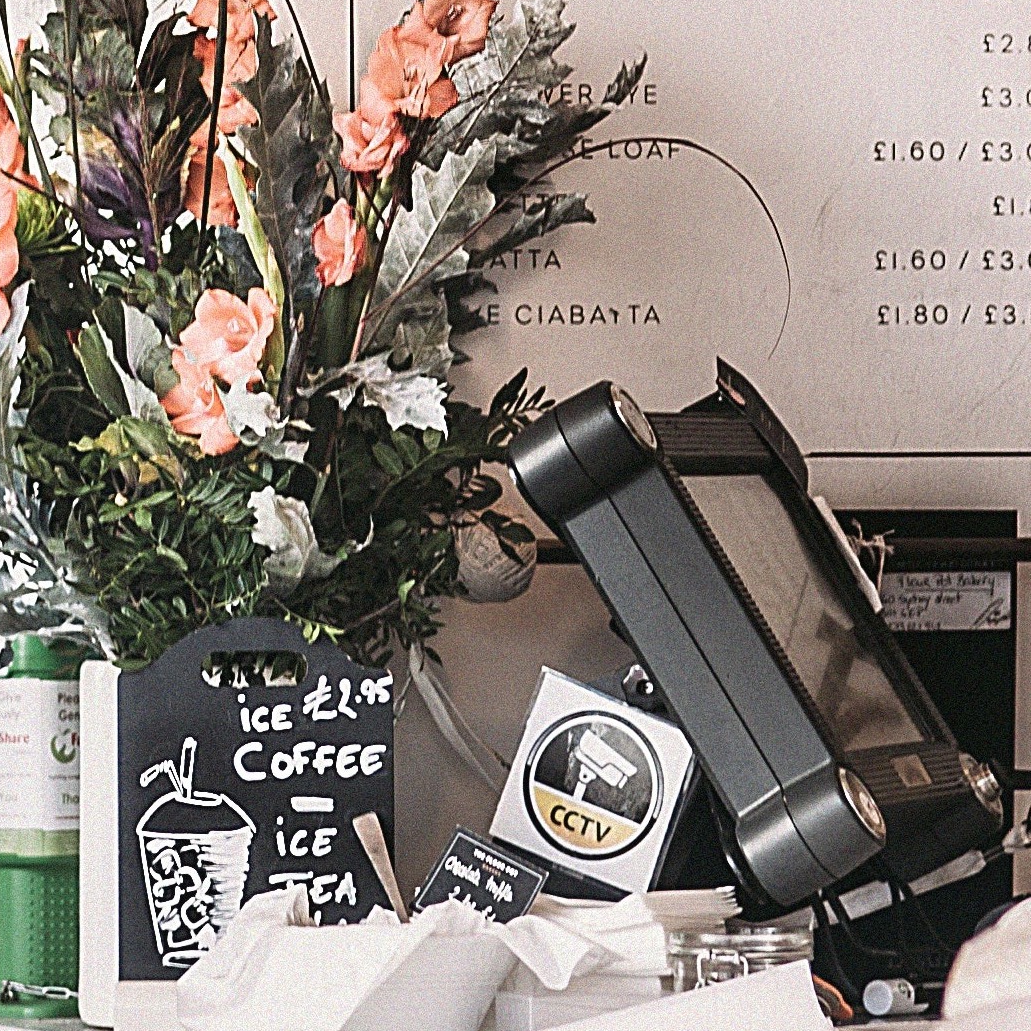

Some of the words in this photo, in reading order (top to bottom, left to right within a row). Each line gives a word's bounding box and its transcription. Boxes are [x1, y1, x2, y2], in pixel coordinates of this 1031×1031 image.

[982, 32, 1031, 54] £2.
[608, 138, 681, 160] LOAF
[873, 140, 945, 162] £1.60
[958, 141, 968, 162] /
[981, 140, 1031, 163] £3.
[993, 195, 1031, 217] £1.
[875, 249, 946, 271] £1.60
[959, 249, 969, 270] /
[982, 249, 1031, 271] £3.
[514, 304, 662, 326] CIABATTA
[877, 304, 948, 326] £1.80
[961, 304, 971, 325] /
[549, 804, 612, 843] CCTV
[268, 870, 358, 906] TEA
